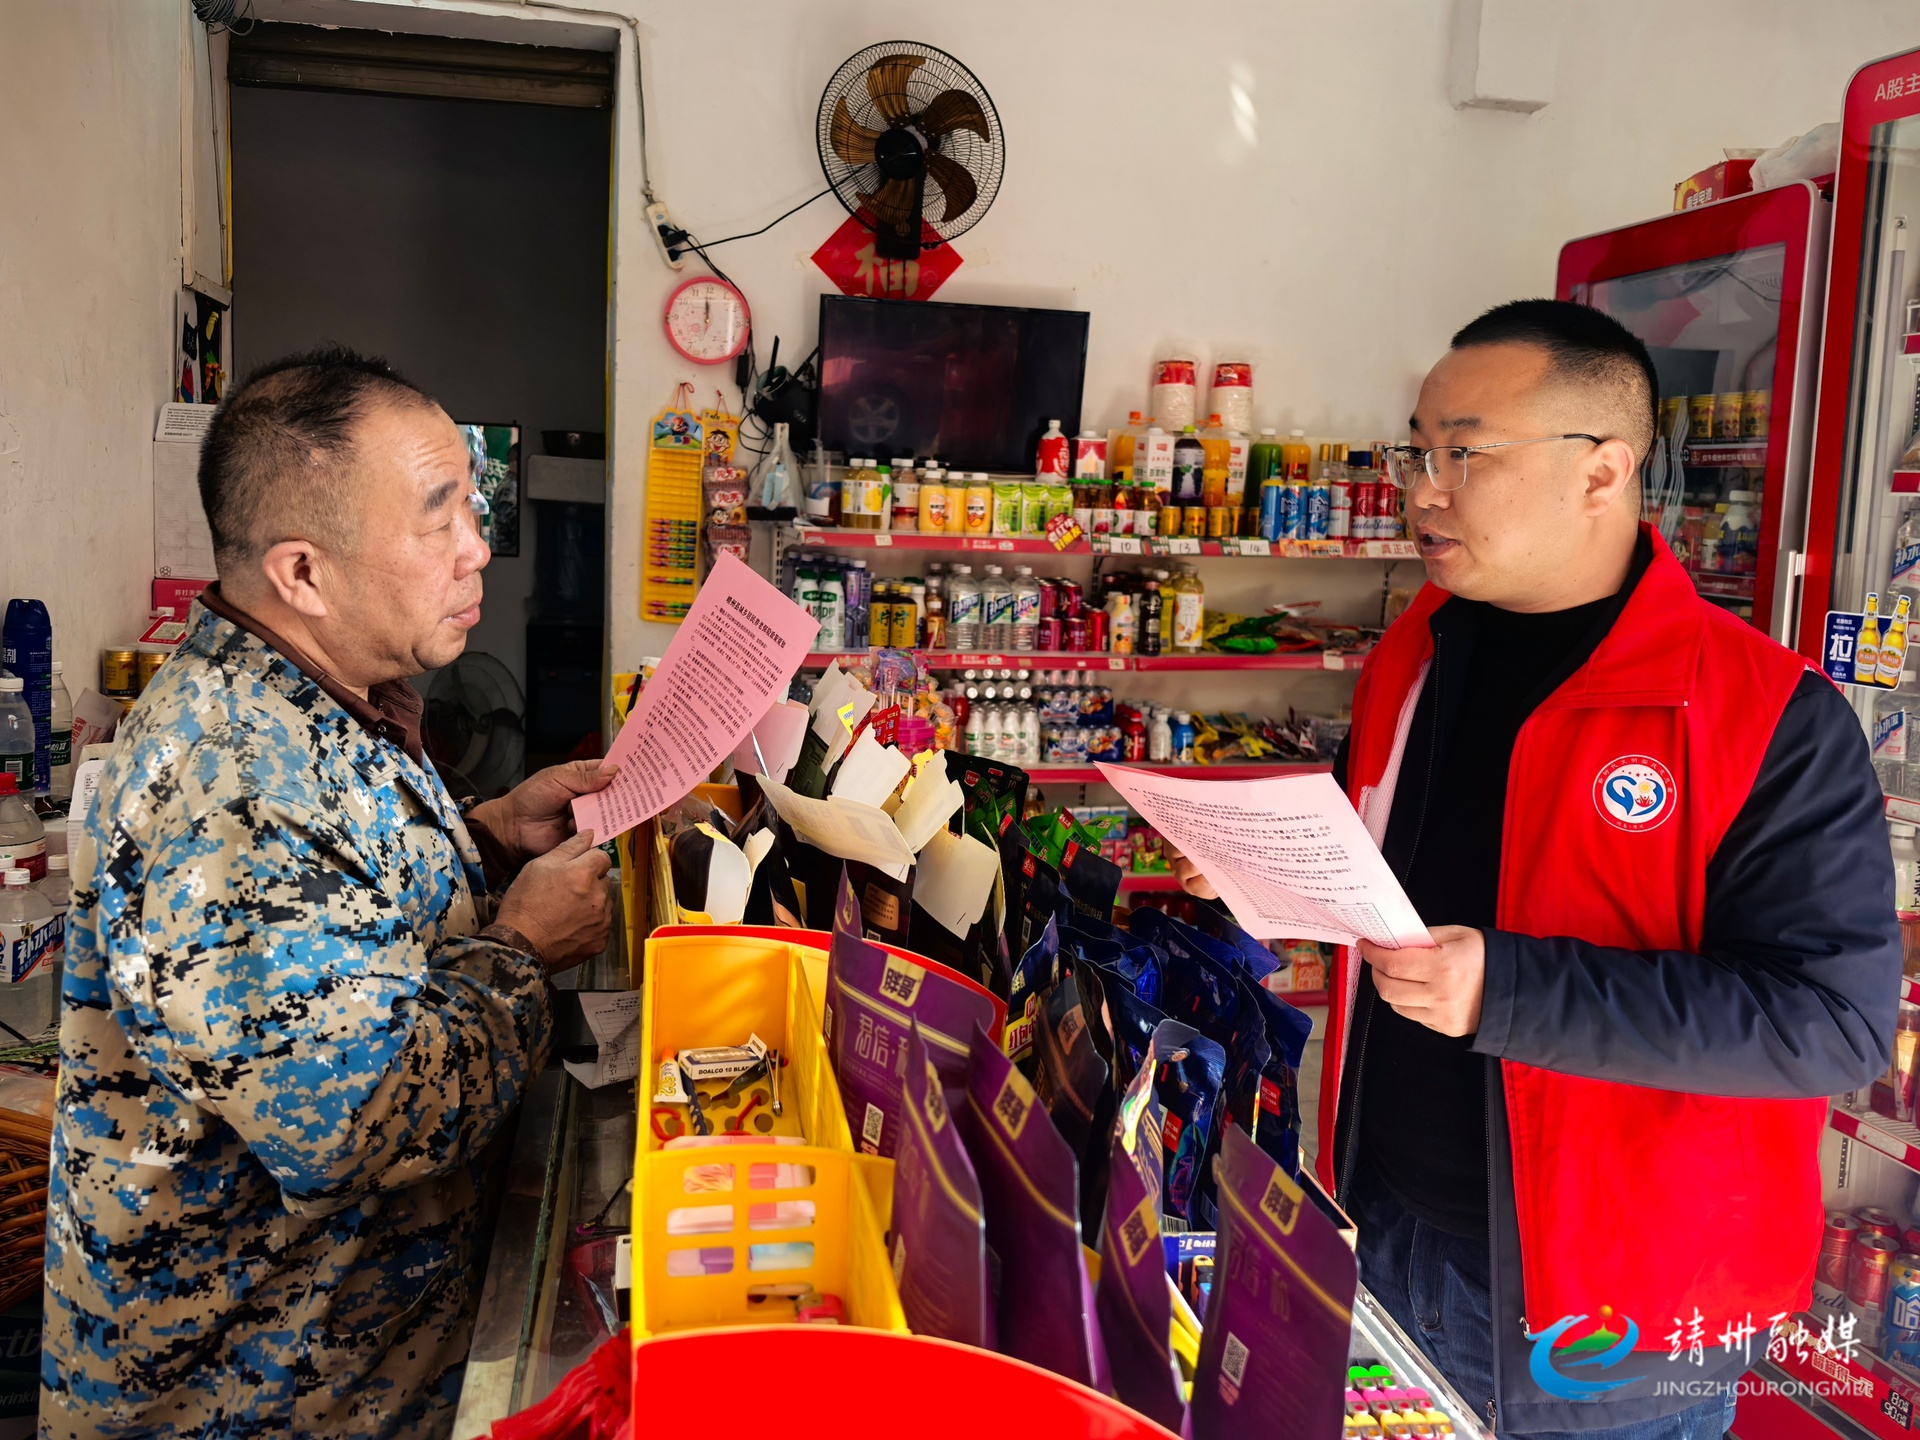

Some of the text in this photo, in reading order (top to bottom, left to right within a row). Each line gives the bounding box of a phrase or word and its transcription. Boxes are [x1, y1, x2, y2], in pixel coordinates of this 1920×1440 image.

[1120, 542, 1132, 552] 10
[1178, 543, 1191, 554] 13
[1250, 543, 1261, 554] 14
[1829, 632, 1854, 662] 拉
[698, 1067, 724, 1075] DOALCO
[660, 1075, 677, 1097] 502
